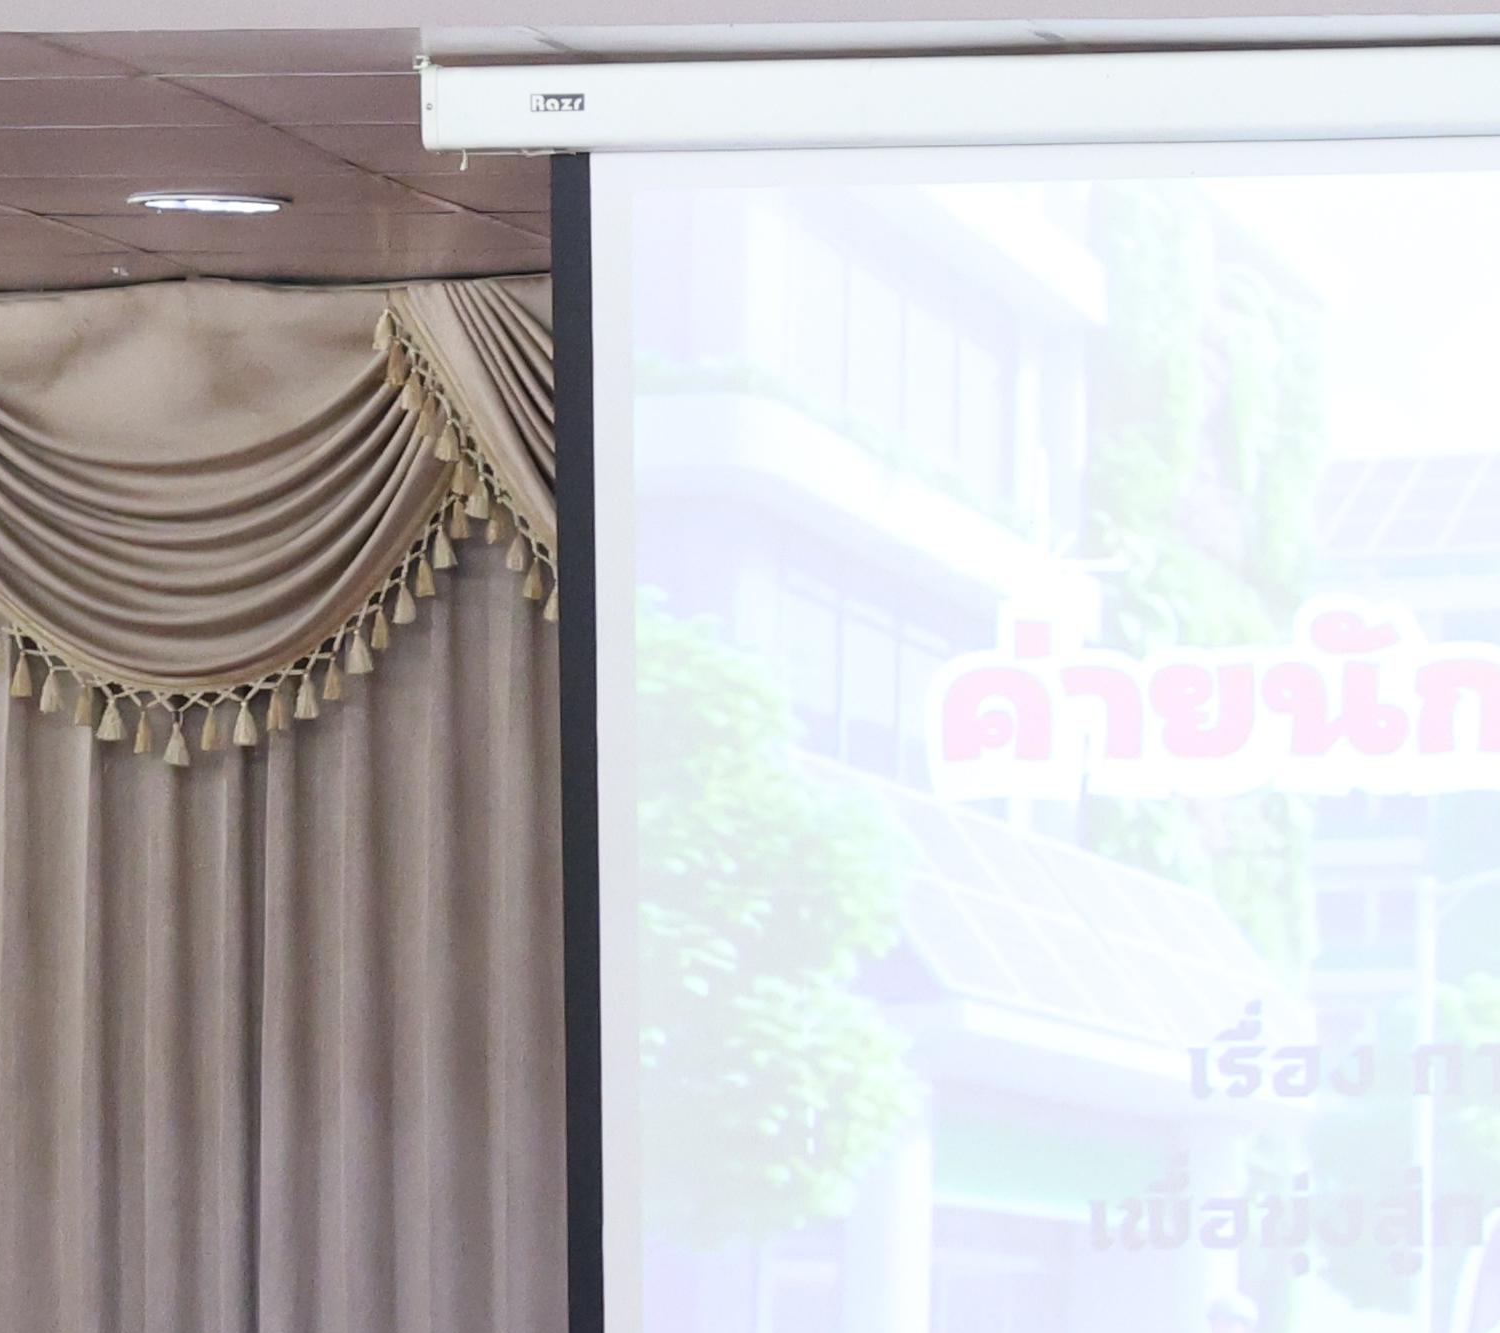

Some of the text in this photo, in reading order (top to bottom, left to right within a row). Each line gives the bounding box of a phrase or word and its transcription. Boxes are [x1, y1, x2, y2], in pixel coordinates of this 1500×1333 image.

[530, 94, 584, 112] Razr
[1187, 1000, 1376, 1099] เรื่อง
